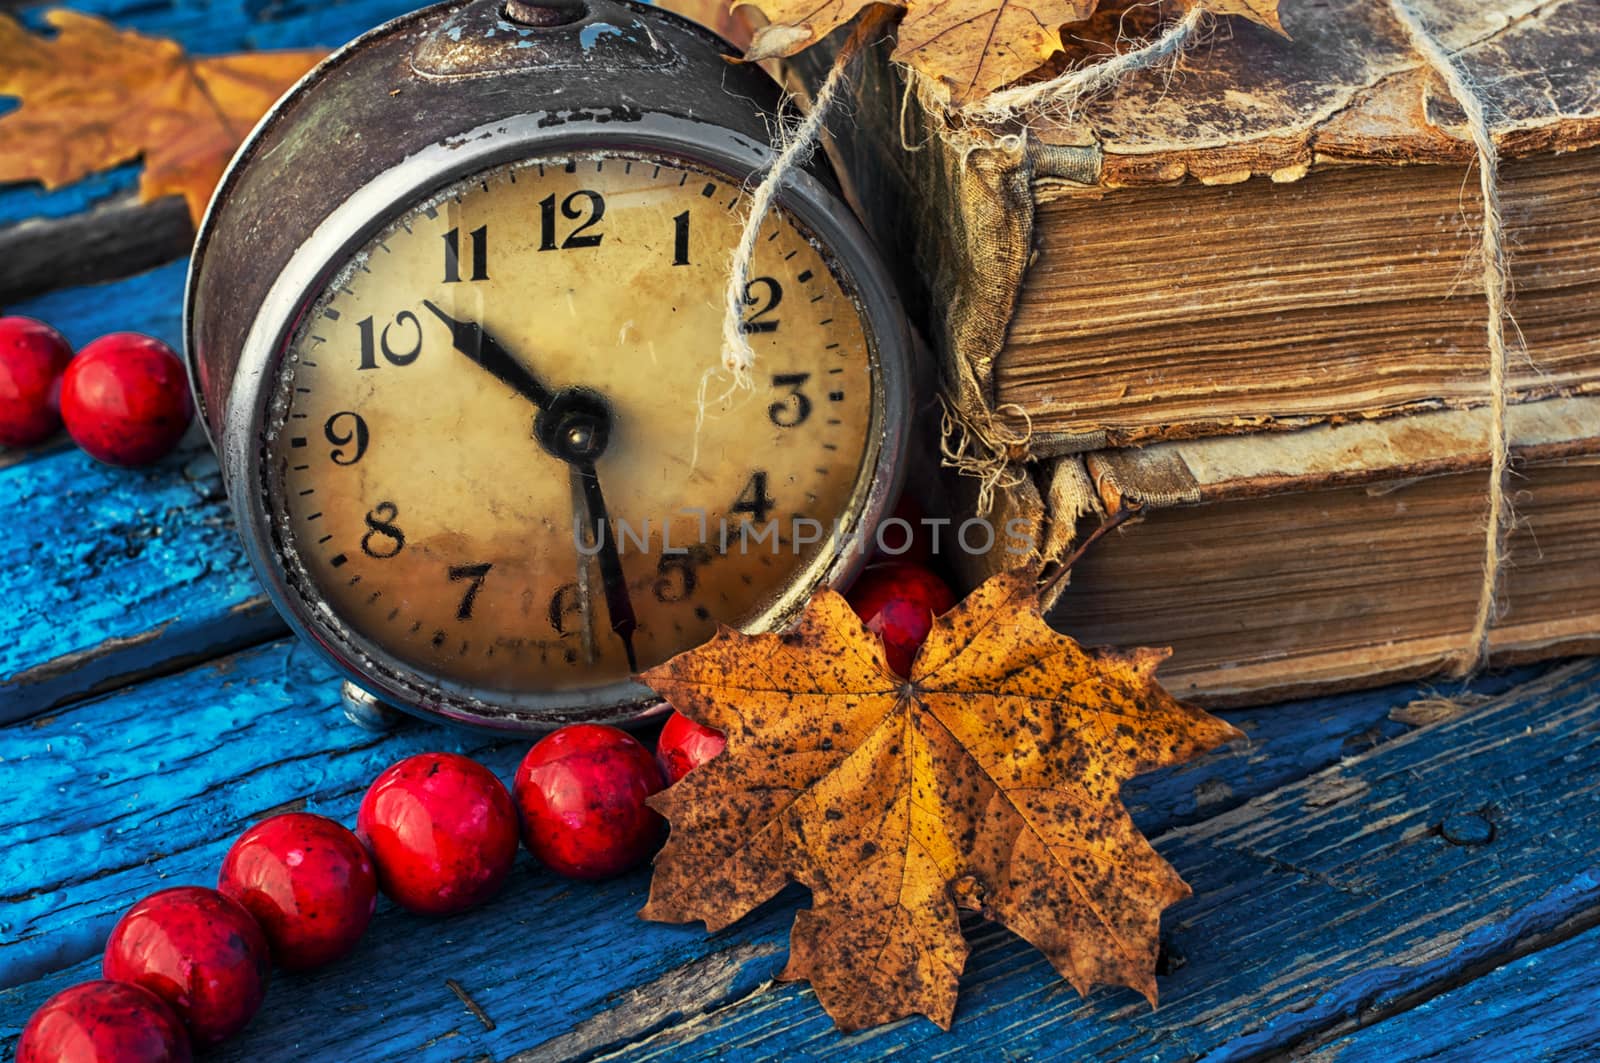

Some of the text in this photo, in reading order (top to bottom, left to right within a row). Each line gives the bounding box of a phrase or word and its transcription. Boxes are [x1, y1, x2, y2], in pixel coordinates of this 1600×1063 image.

[537, 190, 605, 252] 12
[672, 209, 691, 267] 1
[442, 224, 490, 283] 11
[739, 276, 783, 334] 2
[356, 310, 422, 371] 10
[768, 372, 812, 428] 3
[324, 411, 369, 467] 9
[728, 470, 776, 523] 4
[361, 501, 405, 559] 8
[449, 563, 493, 621] 7
